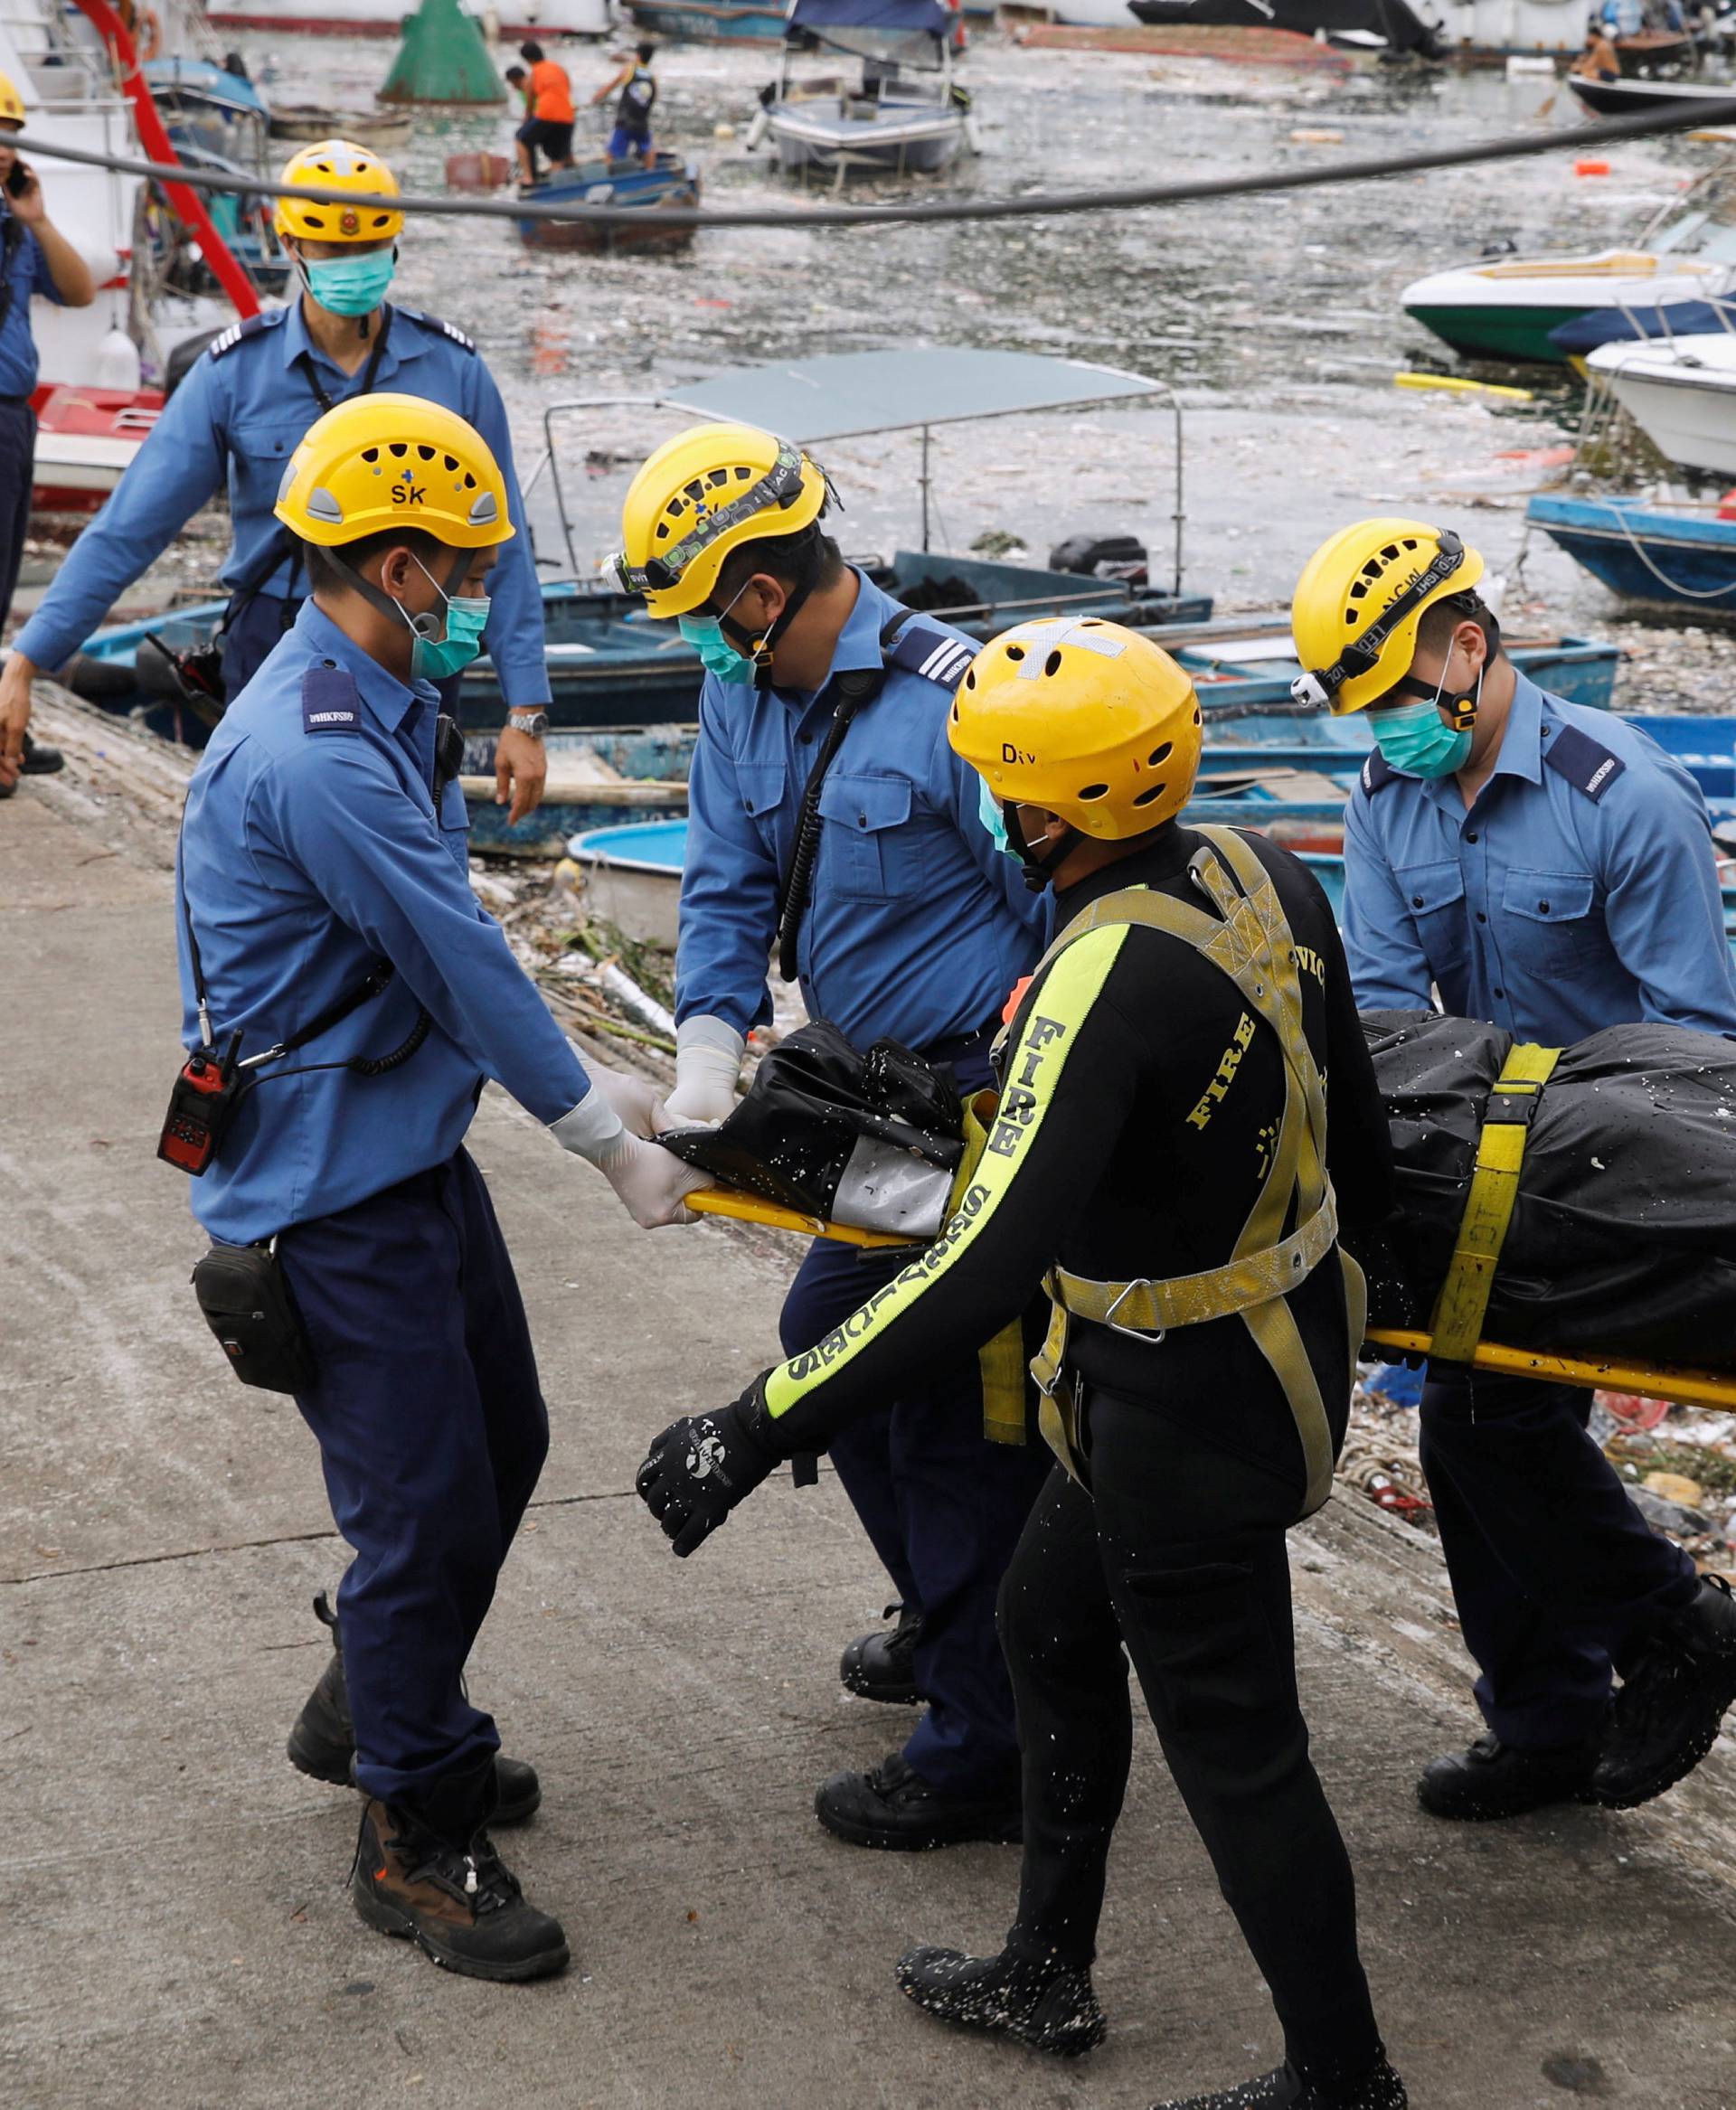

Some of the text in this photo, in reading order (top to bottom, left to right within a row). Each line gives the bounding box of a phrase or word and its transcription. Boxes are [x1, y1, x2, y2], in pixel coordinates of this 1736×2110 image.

[392, 485, 427, 504] SK
[1003, 742, 1035, 765] Div
[1186, 1012, 1256, 1131] FIRE
[788, 1015, 1067, 1380] FIRE SERVICES
